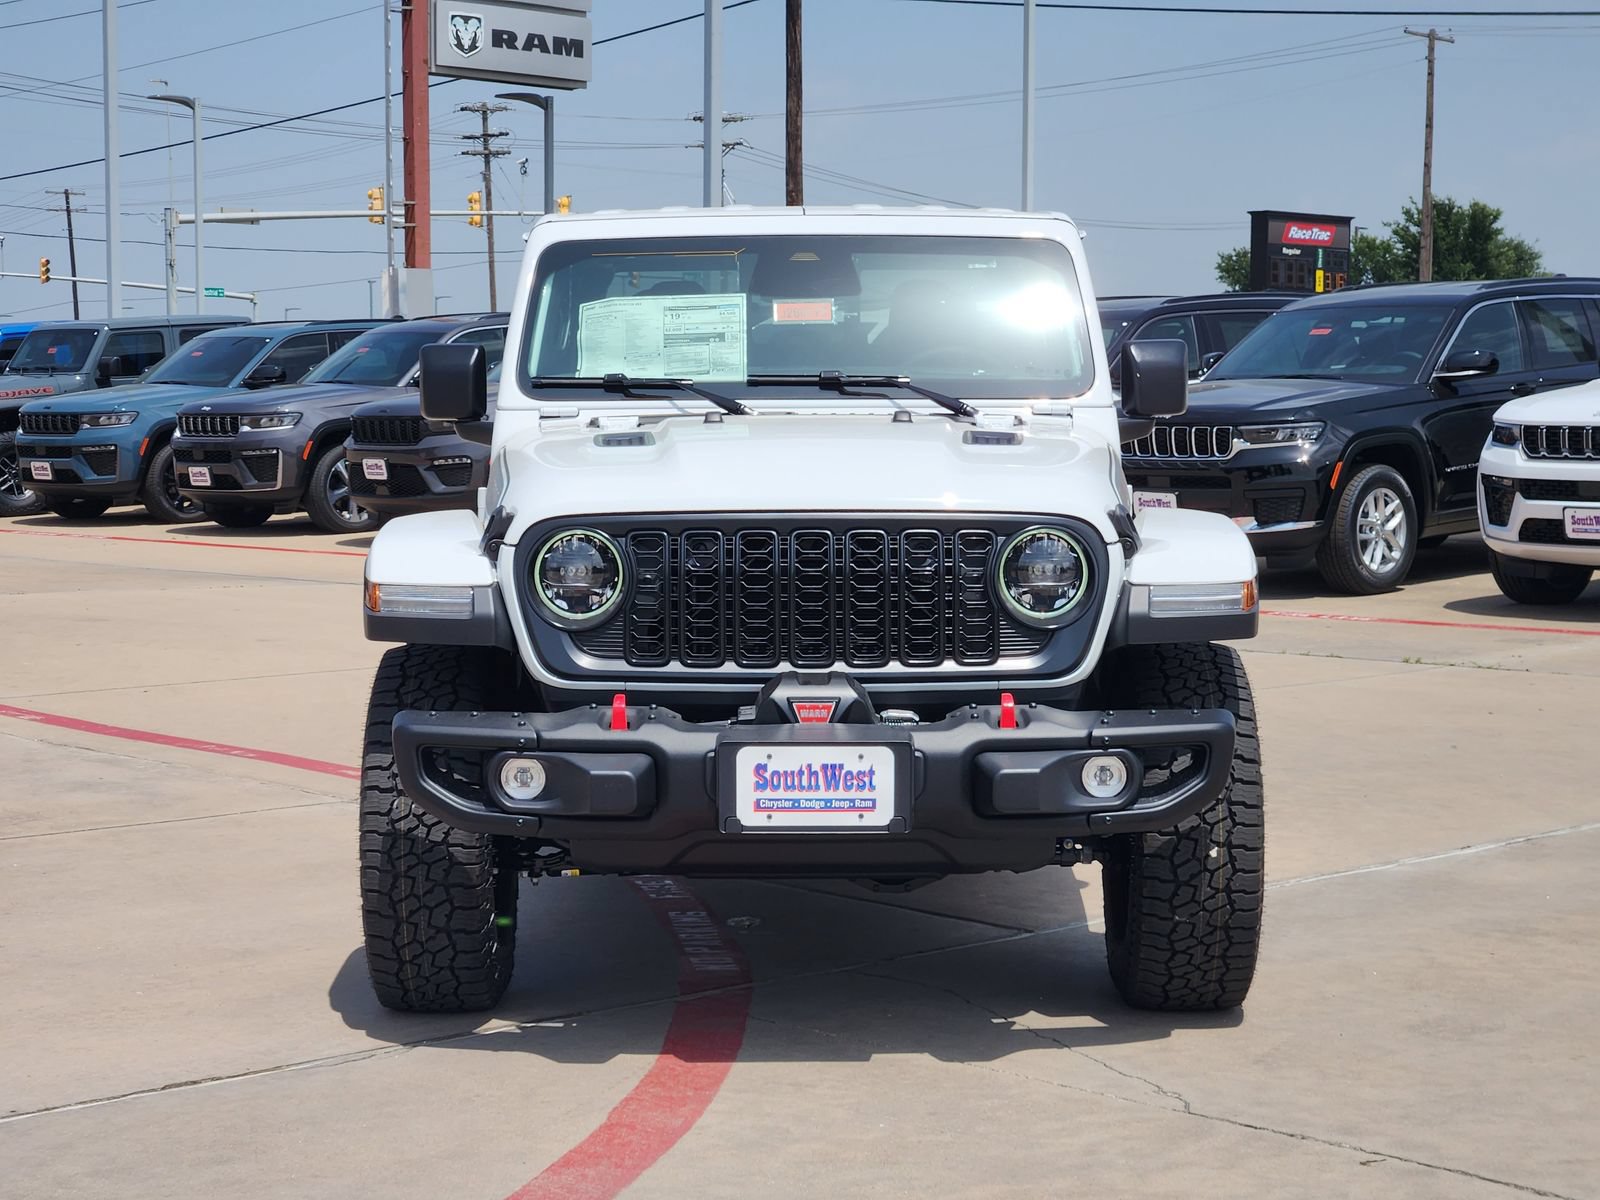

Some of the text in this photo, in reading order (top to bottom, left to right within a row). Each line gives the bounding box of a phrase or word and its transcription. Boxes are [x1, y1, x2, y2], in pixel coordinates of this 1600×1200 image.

[491, 28, 584, 59] RAM
[1288, 226, 1332, 241] RaceTrac
[1282, 246, 1302, 256] Regular
[1138, 497, 1172, 508] SouthWest
[800, 709, 829, 719] WARN
[754, 762, 876, 792] SouthWest
[760, 799, 873, 810] Chrysler Dodge Jeep Ram
[667, 911, 728, 955] PARKING
[689, 956, 740, 972] NO
